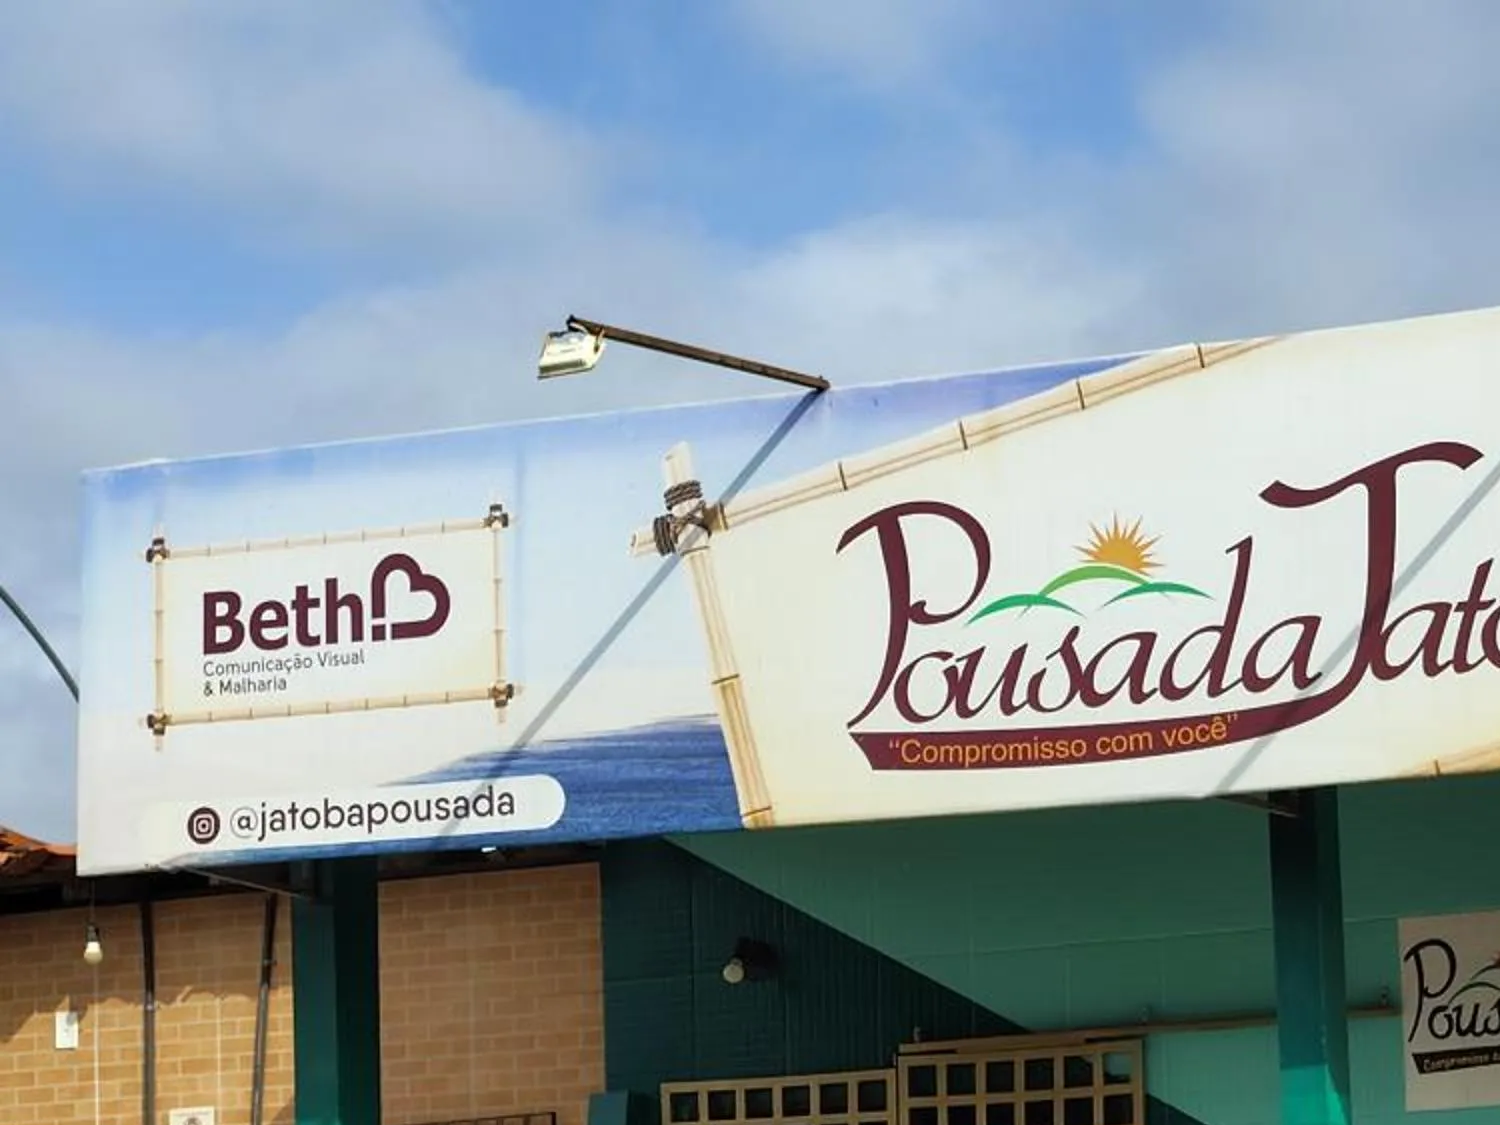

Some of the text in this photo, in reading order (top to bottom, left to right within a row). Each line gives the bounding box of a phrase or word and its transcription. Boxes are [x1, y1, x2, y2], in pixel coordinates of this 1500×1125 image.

[836, 500, 1322, 730] Pousada
[203, 648, 365, 679] Comunicação Visual
[203, 676, 287, 696] & Malharia
[1095, 730, 1154, 755] com
[230, 786, 515, 842] @jatobapousada
